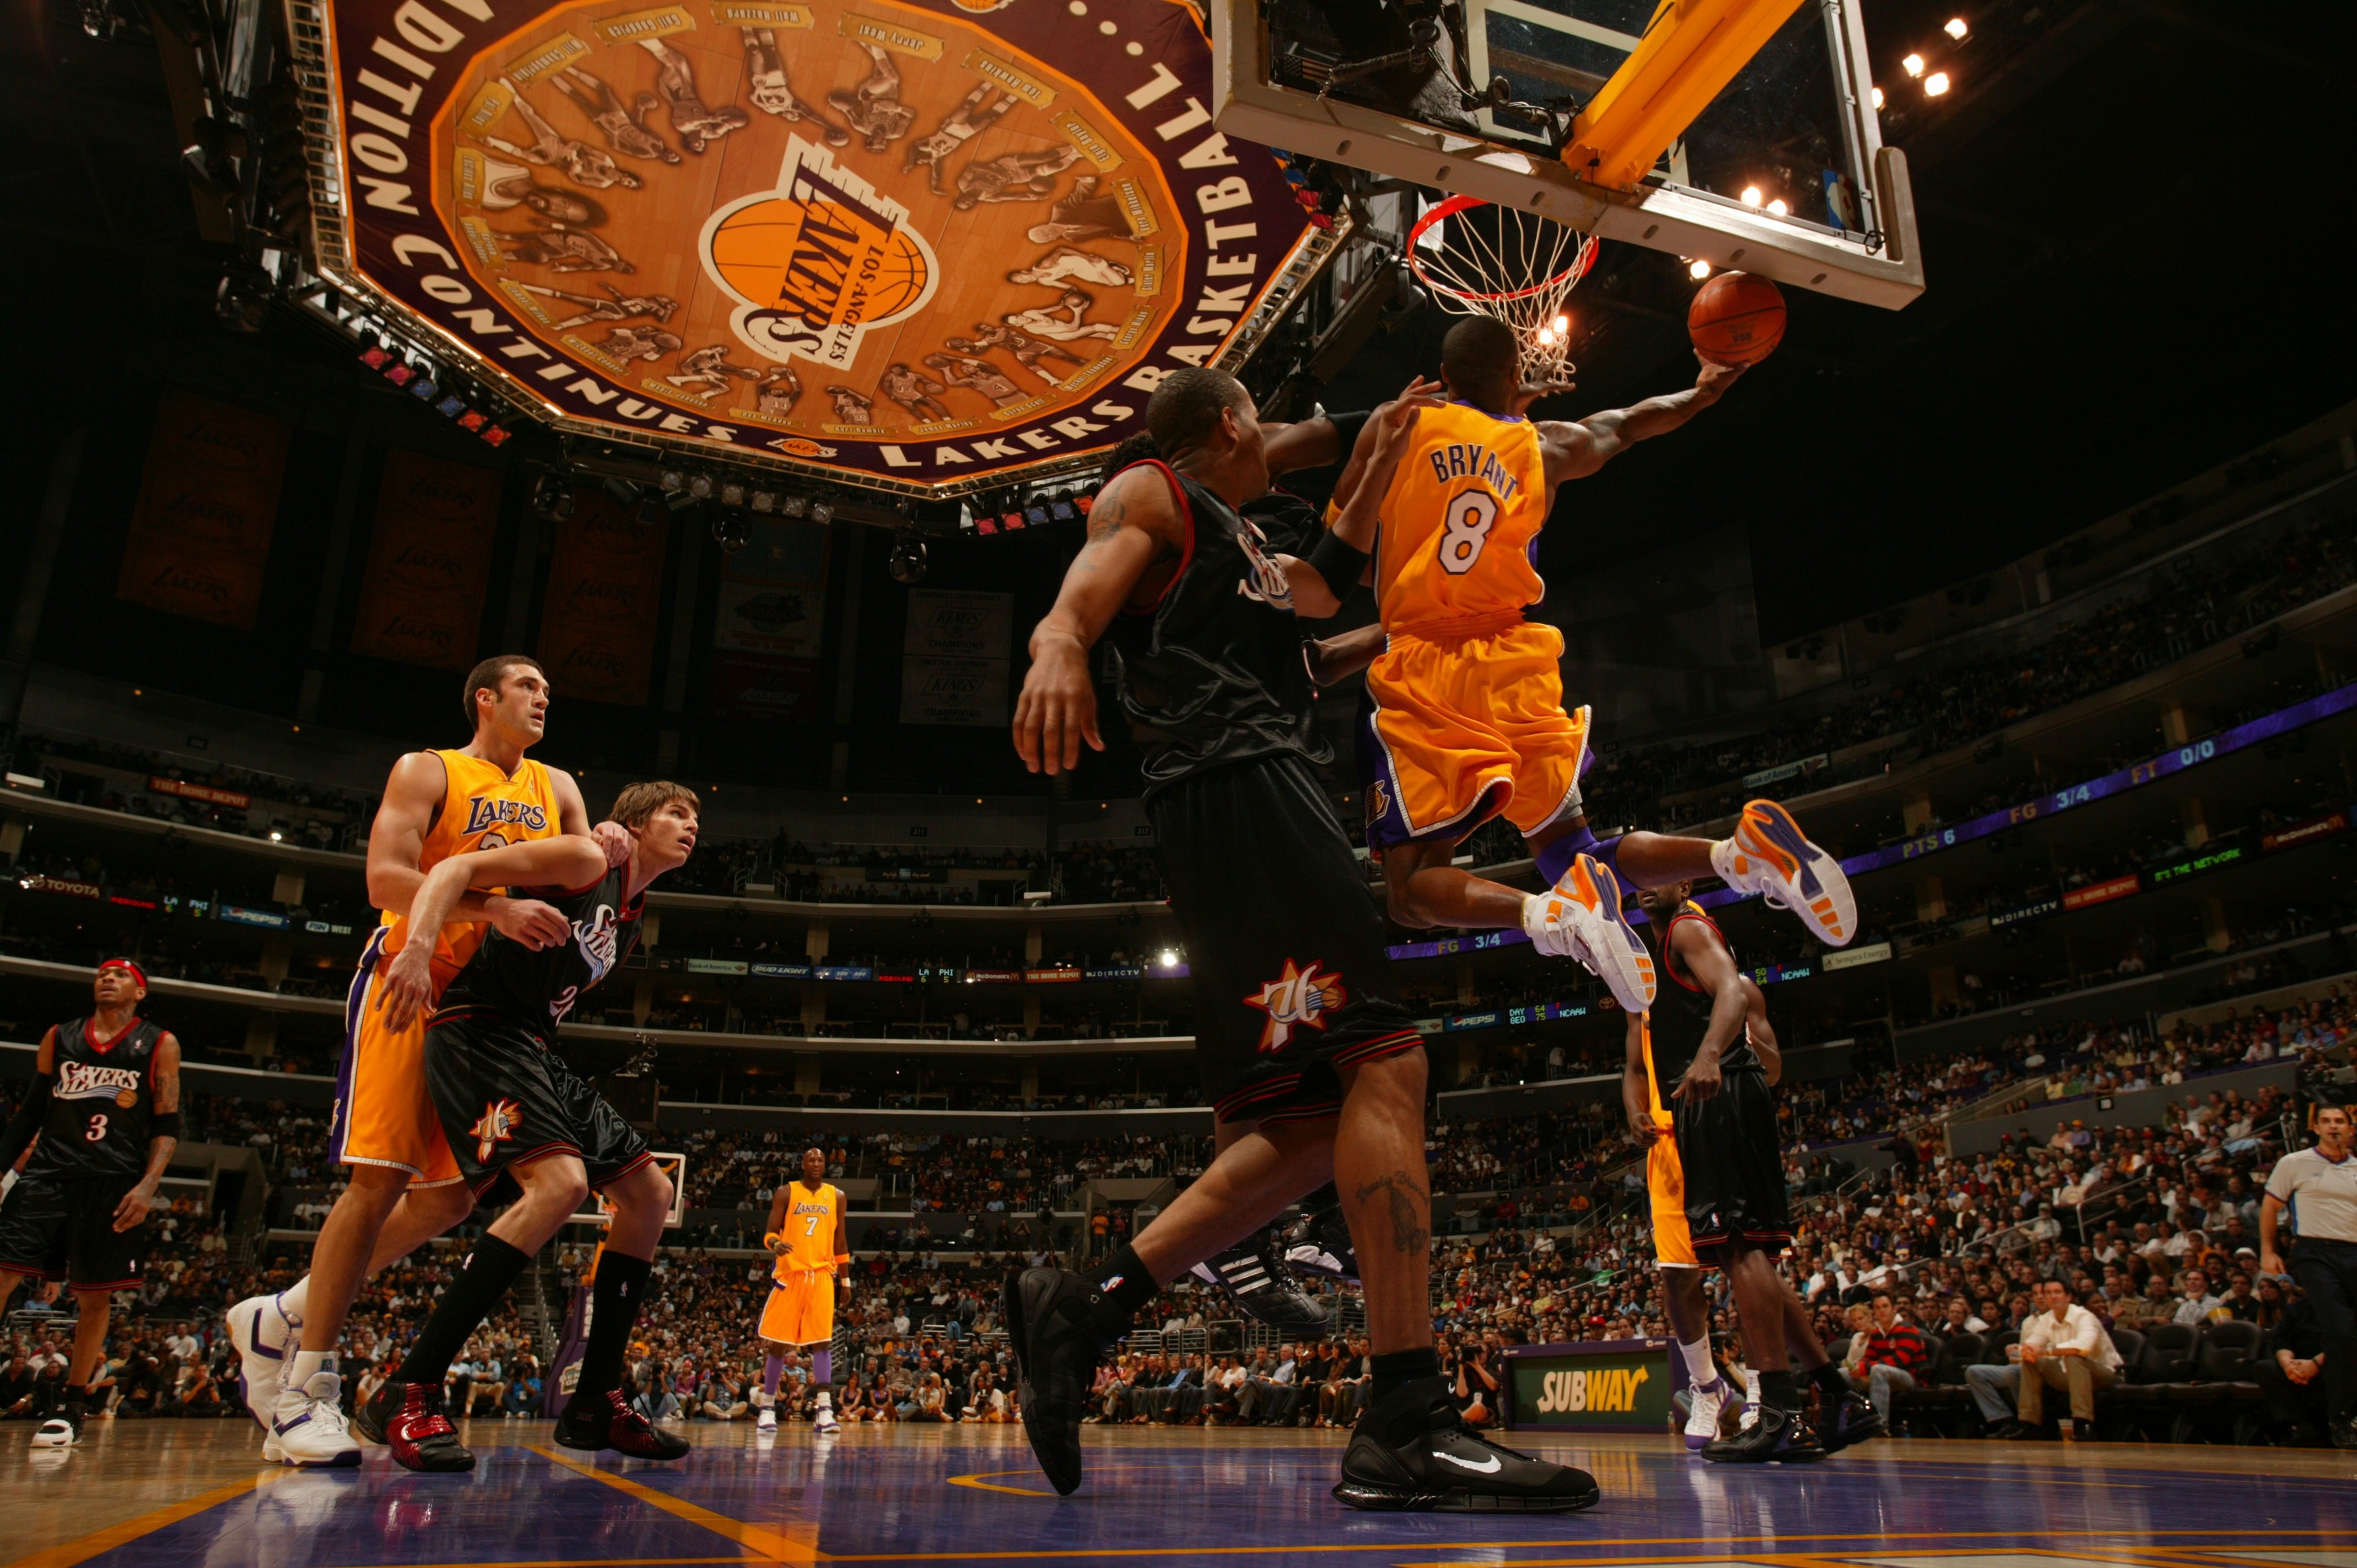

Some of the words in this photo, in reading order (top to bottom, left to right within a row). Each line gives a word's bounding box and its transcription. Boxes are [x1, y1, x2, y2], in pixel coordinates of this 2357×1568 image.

[859, 24, 886, 41] West
[890, 32, 924, 51] Jerry
[979, 59, 1021, 89] Hawkins
[1021, 82, 1041, 99] Tom
[351, 0, 495, 216] DITION
[1066, 121, 1095, 146] Baylor
[1089, 141, 1111, 163] Elgin
[744, 152, 898, 355] LAKERS
[859, 244, 884, 283] LOS
[878, 399, 1134, 467] LAKERS
[1123, 62, 1258, 394] BASKETBALL
[829, 283, 869, 362] ANGELES
[1118, 324, 1137, 345] George
[1131, 310, 1149, 328] Mikan
[392, 234, 738, 442] CONTINUES
[649, 381, 673, 397] Magic
[1430, 443, 1519, 502] BRYANT
[1437, 488, 1499, 575] 8
[936, 610, 983, 625] KINGS
[929, 639, 985, 650] CHAMPIONS
[931, 678, 979, 692] KINGS
[924, 708, 982, 718] CHAMPIONS
[2009, 802, 2037, 825] FG
[2056, 784, 2090, 809] 3/4
[2131, 760, 2157, 784] FT
[2179, 740, 2215, 766] 0/0
[154, 780, 178, 792] THE
[213, 791, 247, 806] DEPOT
[461, 796, 547, 836] LAKERS
[2276, 822, 2328, 844] McDonald's
[1902, 835, 1938, 859] PTS
[1943, 829, 1956, 845] 6
[2155, 868, 2171, 882] IT'S
[2173, 862, 2191, 876] THE
[2193, 847, 2242, 870] NETWORK
[47, 878, 100, 898] TOYOTA
[164, 895, 178, 905] LA
[189, 899, 209, 911] PHI
[242, 910, 284, 927] PEPSI
[2005, 901, 2058, 923] DIRECTV
[331, 925, 352, 935] WEST
[1436, 940, 1459, 955] FG
[1475, 933, 1501, 949] 3/4
[1835, 953, 1863, 965] Sempra
[1863, 948, 1890, 961] Energy
[709, 963, 732, 971] America
[778, 967, 810, 975] LIGHT
[1097, 969, 1140, 978] DIRECTV
[1755, 967, 1767, 977] 50
[1776, 964, 1783, 972] F
[1782, 968, 1810, 981] NCAAW
[1756, 977, 1768, 986] 64
[1509, 1007, 1526, 1017] DAY
[1534, 1004, 1546, 1013] 64
[1535, 1013, 1547, 1021] 75
[1559, 1007, 1587, 1018] NCAAW
[1461, 1013, 1496, 1026] PEPSI
[1509, 1015, 1526, 1025] GEO
[53, 1060, 142, 1098] SIXERS
[85, 1114, 109, 1143] 3
[794, 1202, 829, 1215] LAKERS
[805, 1216, 819, 1236] 7
[1537, 1364, 1649, 1414] SUBWAY
